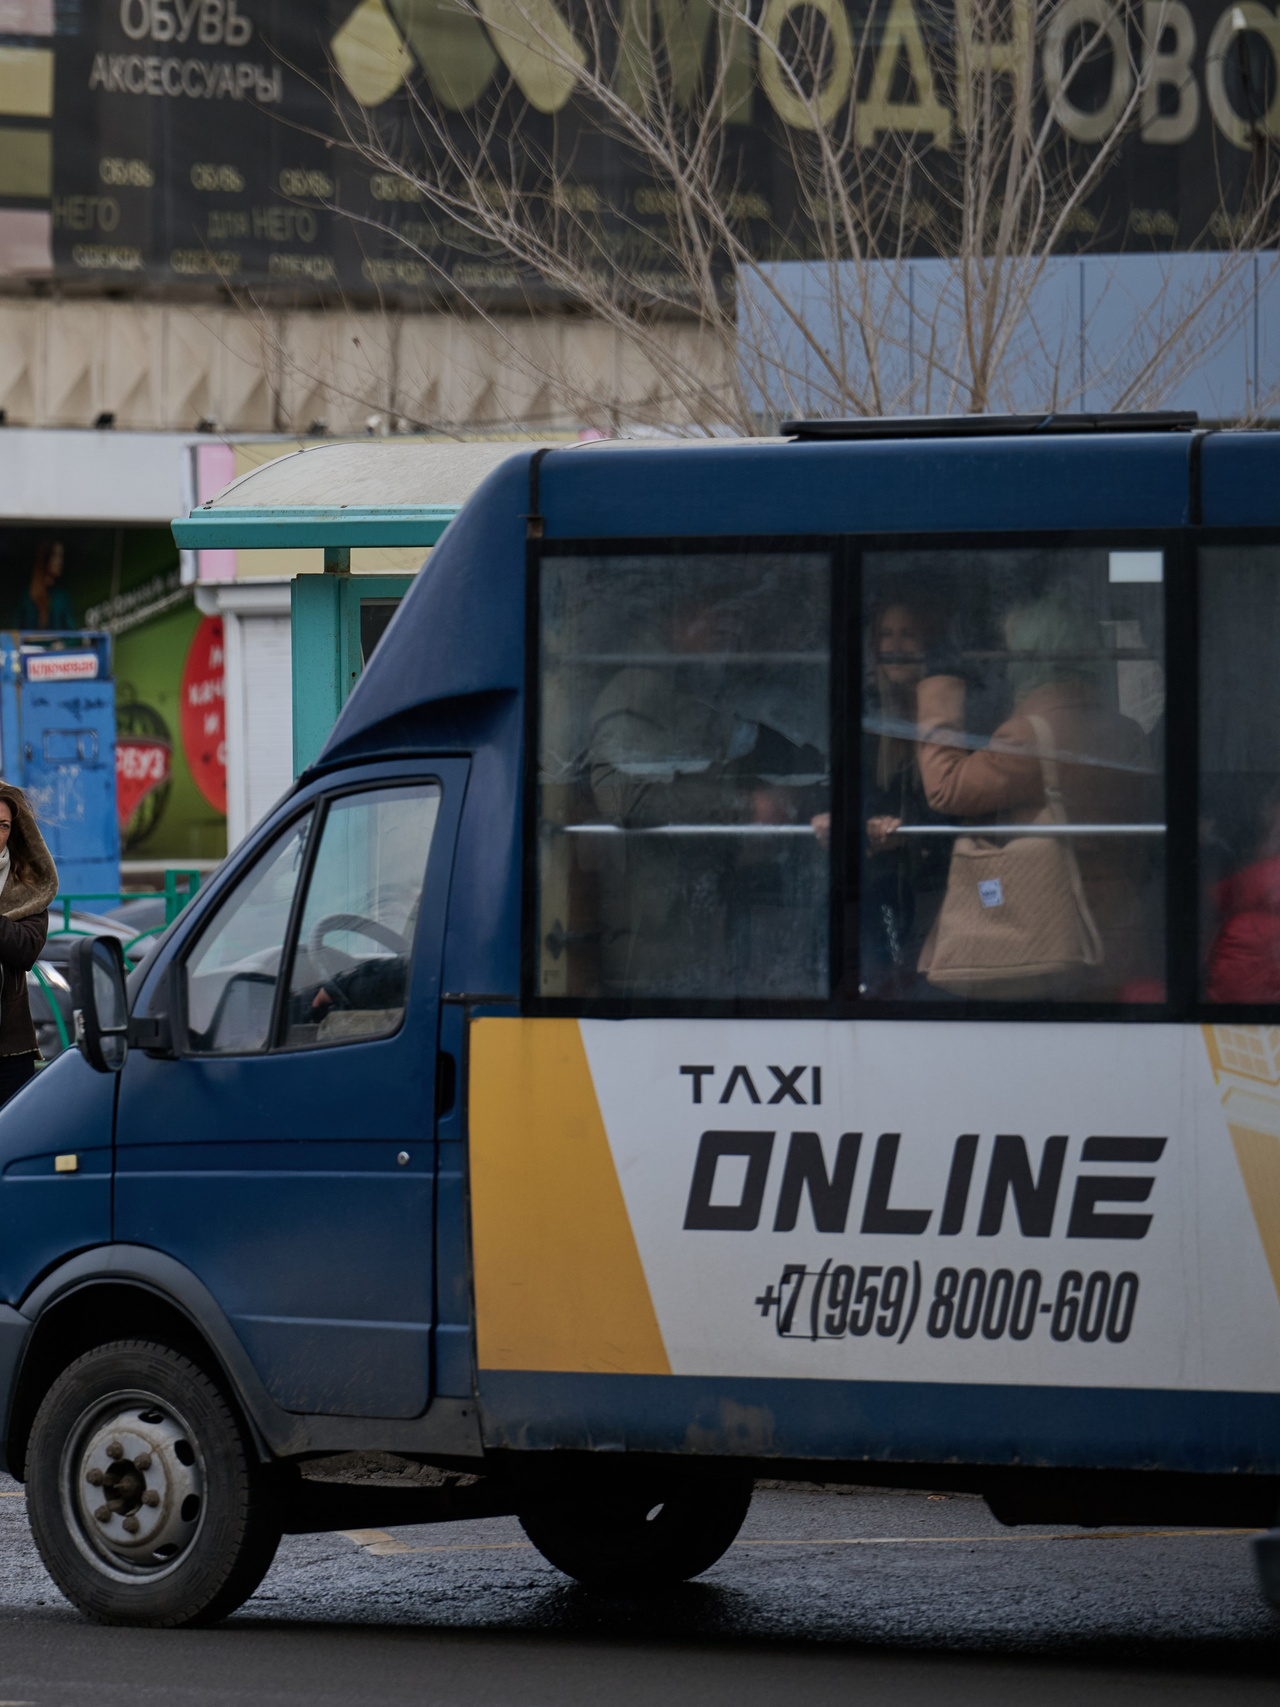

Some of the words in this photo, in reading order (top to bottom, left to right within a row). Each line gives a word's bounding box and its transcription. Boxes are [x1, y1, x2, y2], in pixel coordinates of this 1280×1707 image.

[121, 0, 253, 46] ОБУВЬ
[87, 52, 283, 102] АКСЕССУАРЫ
[252, 205, 318, 243] НЕГО
[679, 1065, 822, 1105] TAXI
[683, 1130, 1168, 1240] ONLINE
[926, 1267, 1140, 1344] 8000-600
